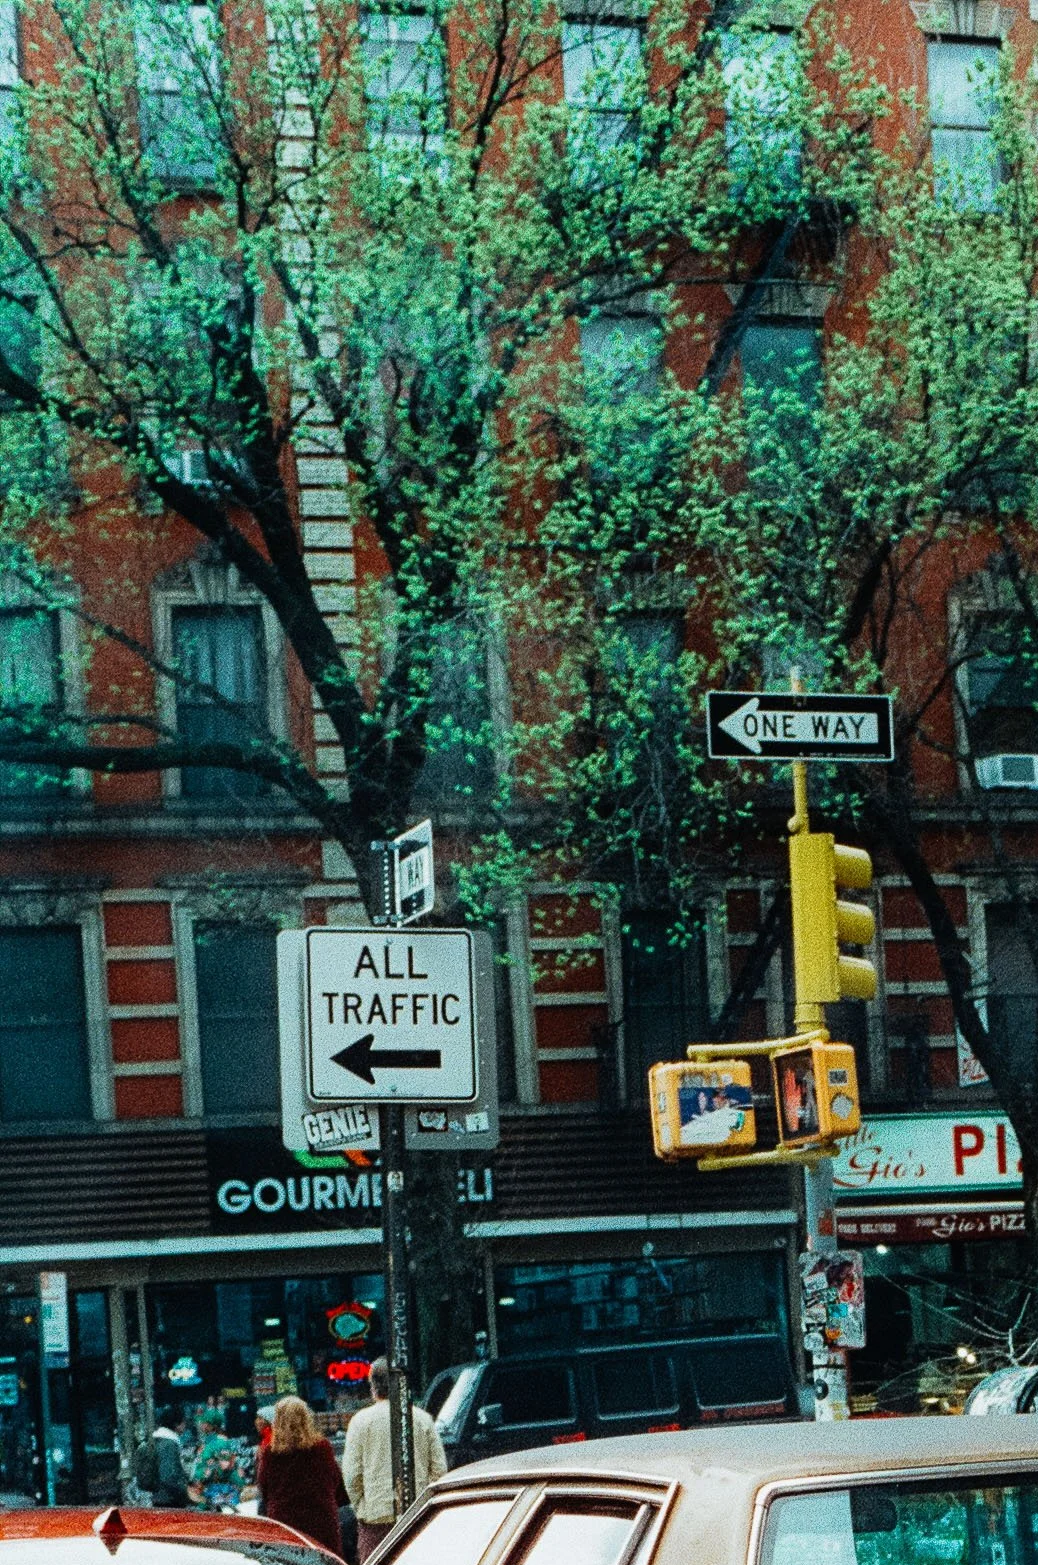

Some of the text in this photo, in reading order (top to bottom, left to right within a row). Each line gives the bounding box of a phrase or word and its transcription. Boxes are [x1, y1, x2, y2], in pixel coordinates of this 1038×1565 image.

[743, 713, 866, 739] ONE WAY
[354, 945, 429, 980] ALL
[322, 992, 460, 1026] TRAFFIC
[303, 1105, 371, 1146] GENIE
[833, 1146, 927, 1188] Gio's
